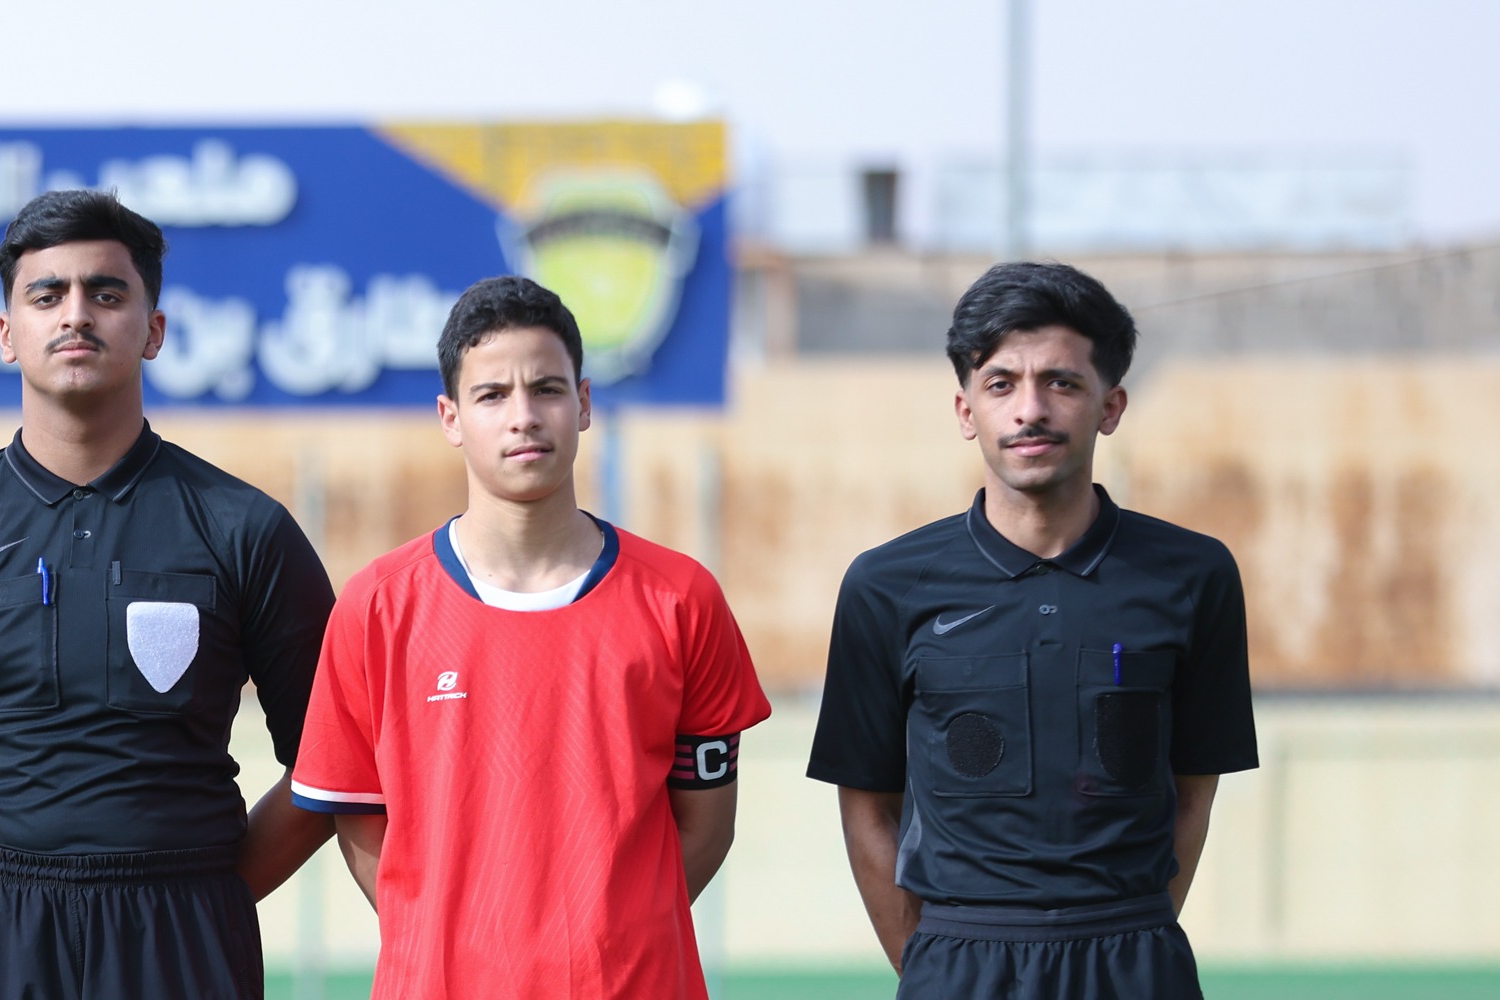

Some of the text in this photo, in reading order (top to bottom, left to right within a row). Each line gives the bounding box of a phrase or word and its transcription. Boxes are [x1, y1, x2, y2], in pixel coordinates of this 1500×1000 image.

[46, 139, 297, 227] ملع
[147, 290, 256, 399] بن
[696, 740, 728, 781] C
